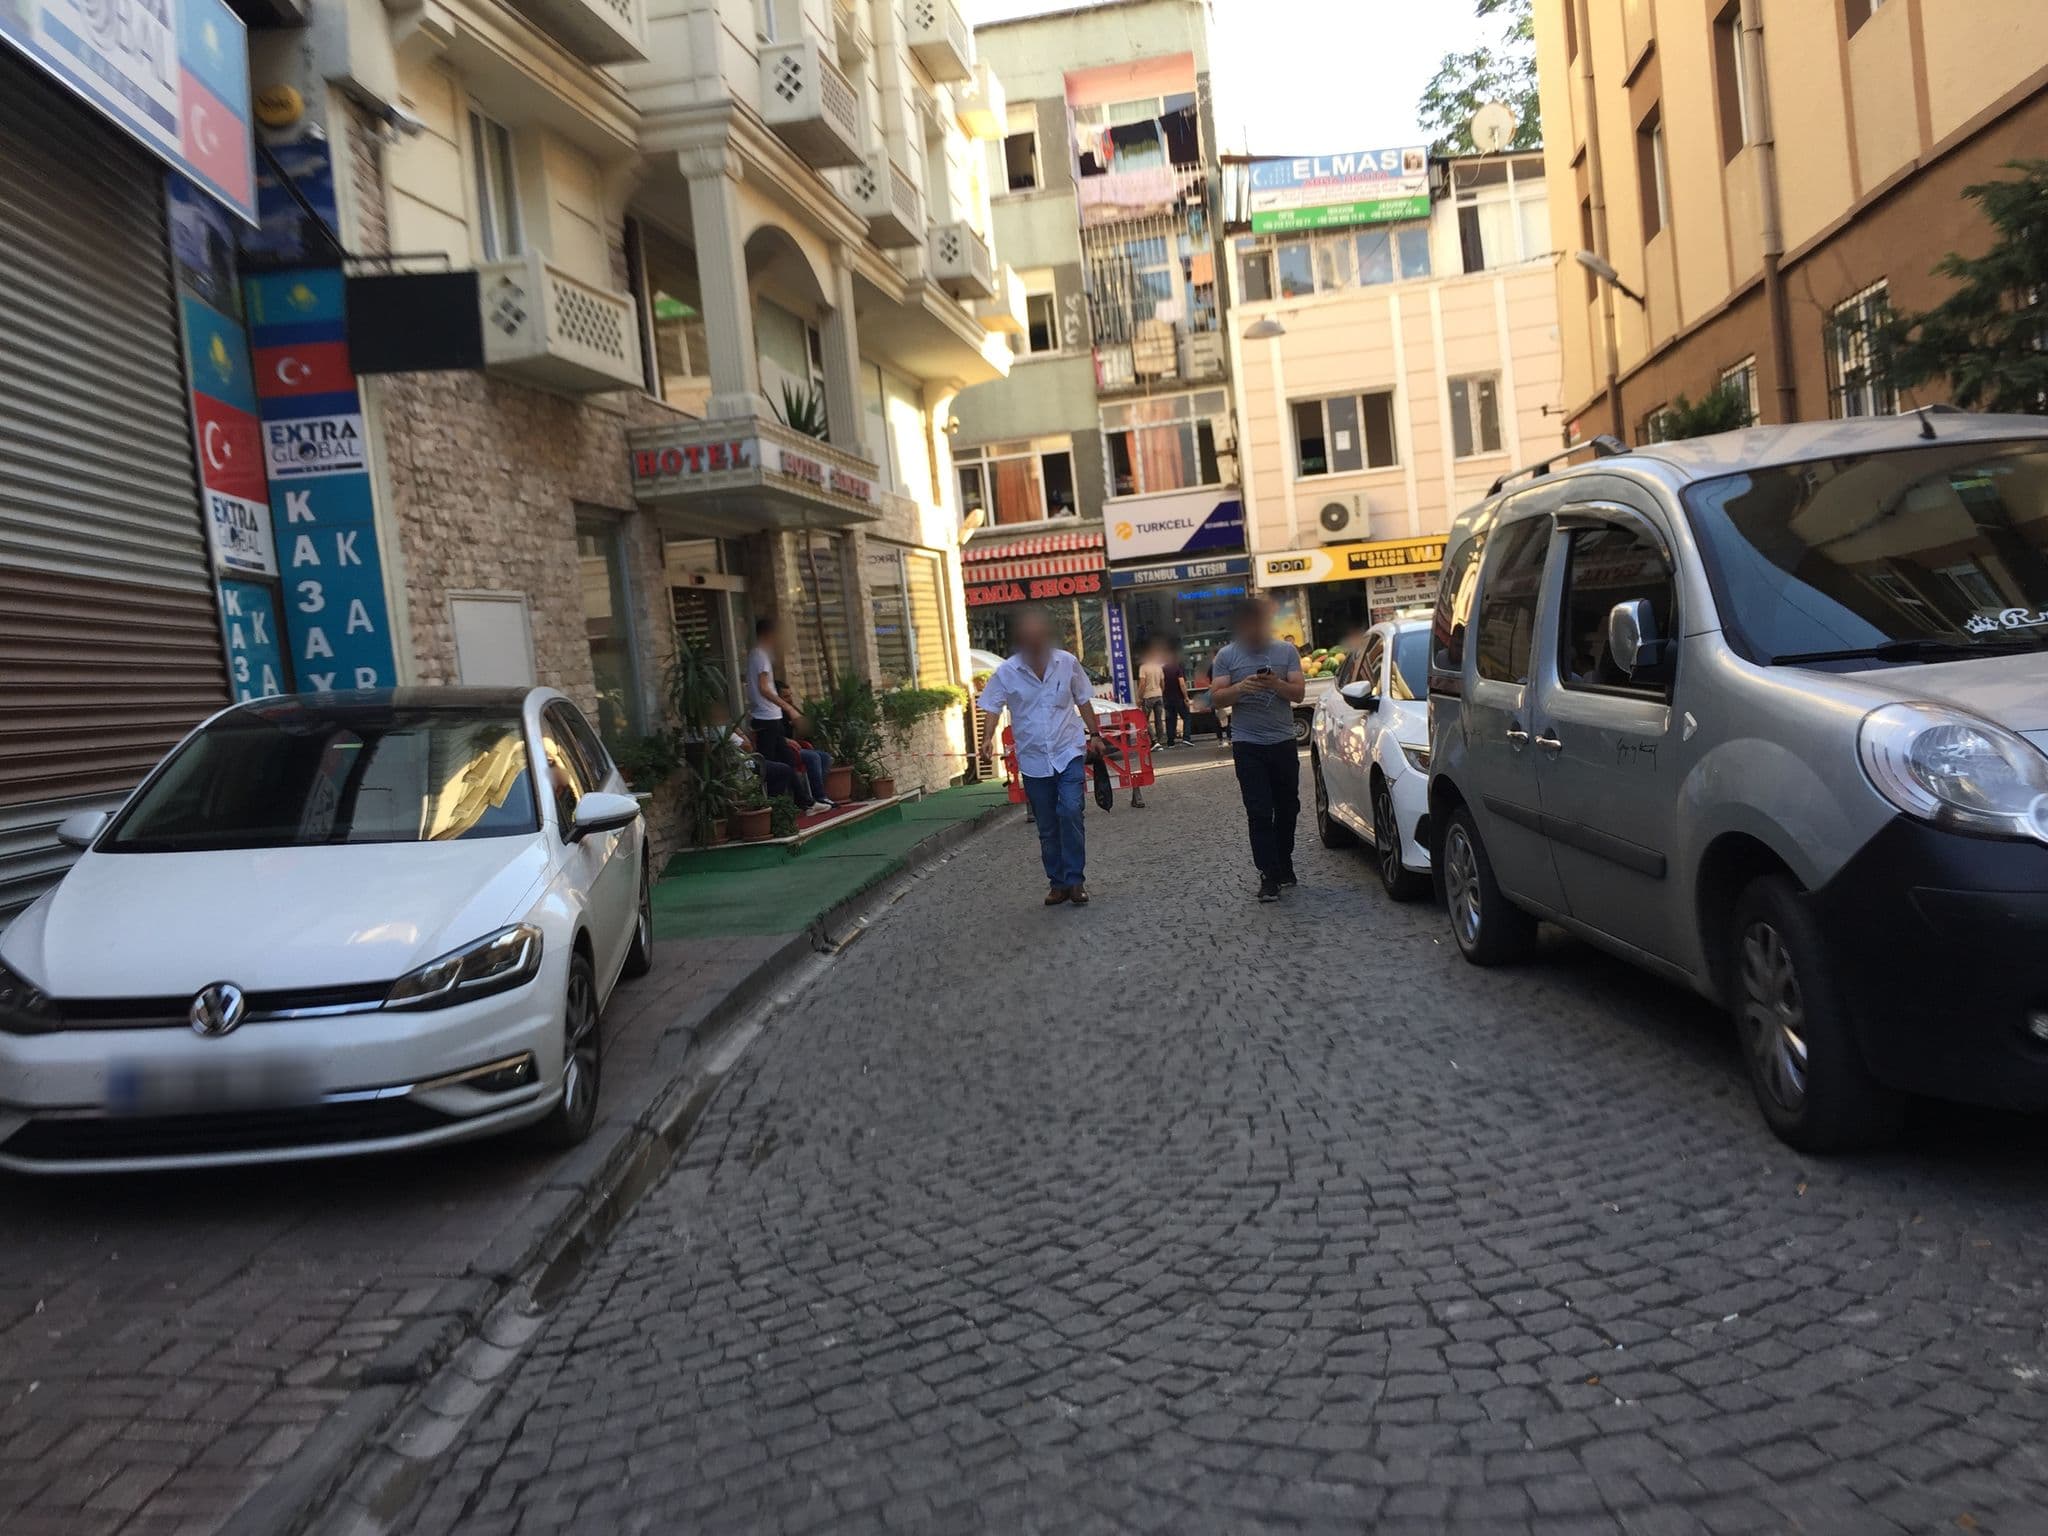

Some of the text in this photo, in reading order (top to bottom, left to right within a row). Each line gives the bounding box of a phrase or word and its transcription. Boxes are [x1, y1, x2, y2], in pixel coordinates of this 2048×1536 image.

[1292, 149, 1399, 180] ELMAS
[270, 420, 357, 444] EXTRA
[272, 440, 360, 463] GLOBAL
[636, 441, 751, 479] HOTEL
[212, 495, 259, 532] EXTRA
[1136, 518, 1195, 534] TURKCELL
[1350, 545, 1443, 563] WESTERN WU
[1367, 555, 1406, 568] UNION
[1030, 572, 1102, 599] SHOES
